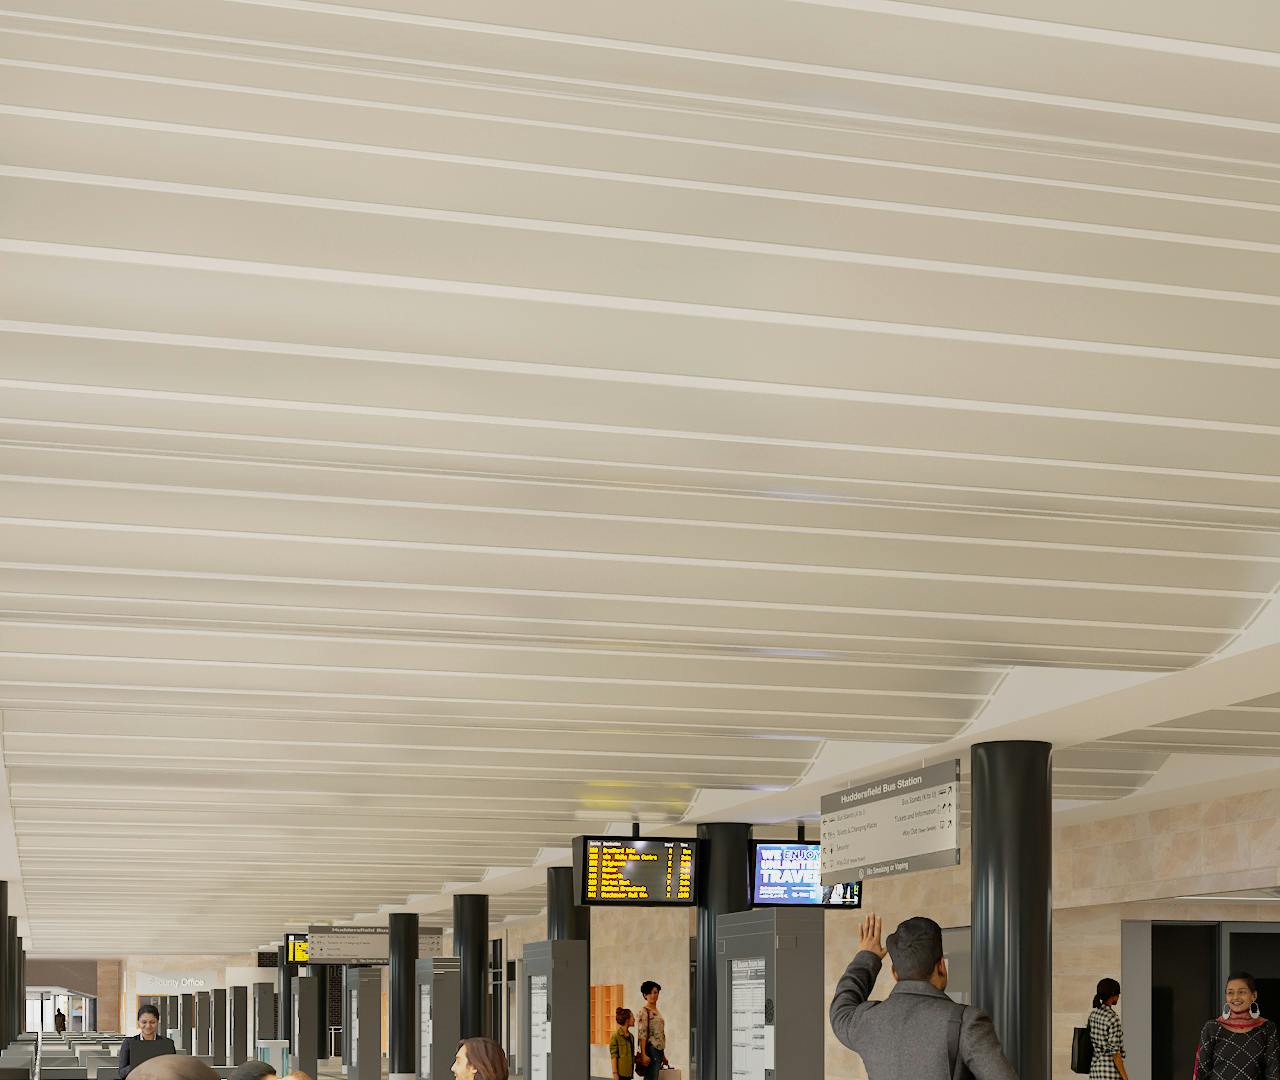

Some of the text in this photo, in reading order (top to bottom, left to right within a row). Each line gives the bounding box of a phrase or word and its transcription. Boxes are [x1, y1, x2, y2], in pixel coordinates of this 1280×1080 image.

[841, 776, 922, 804] Huddersfield Bus Station
